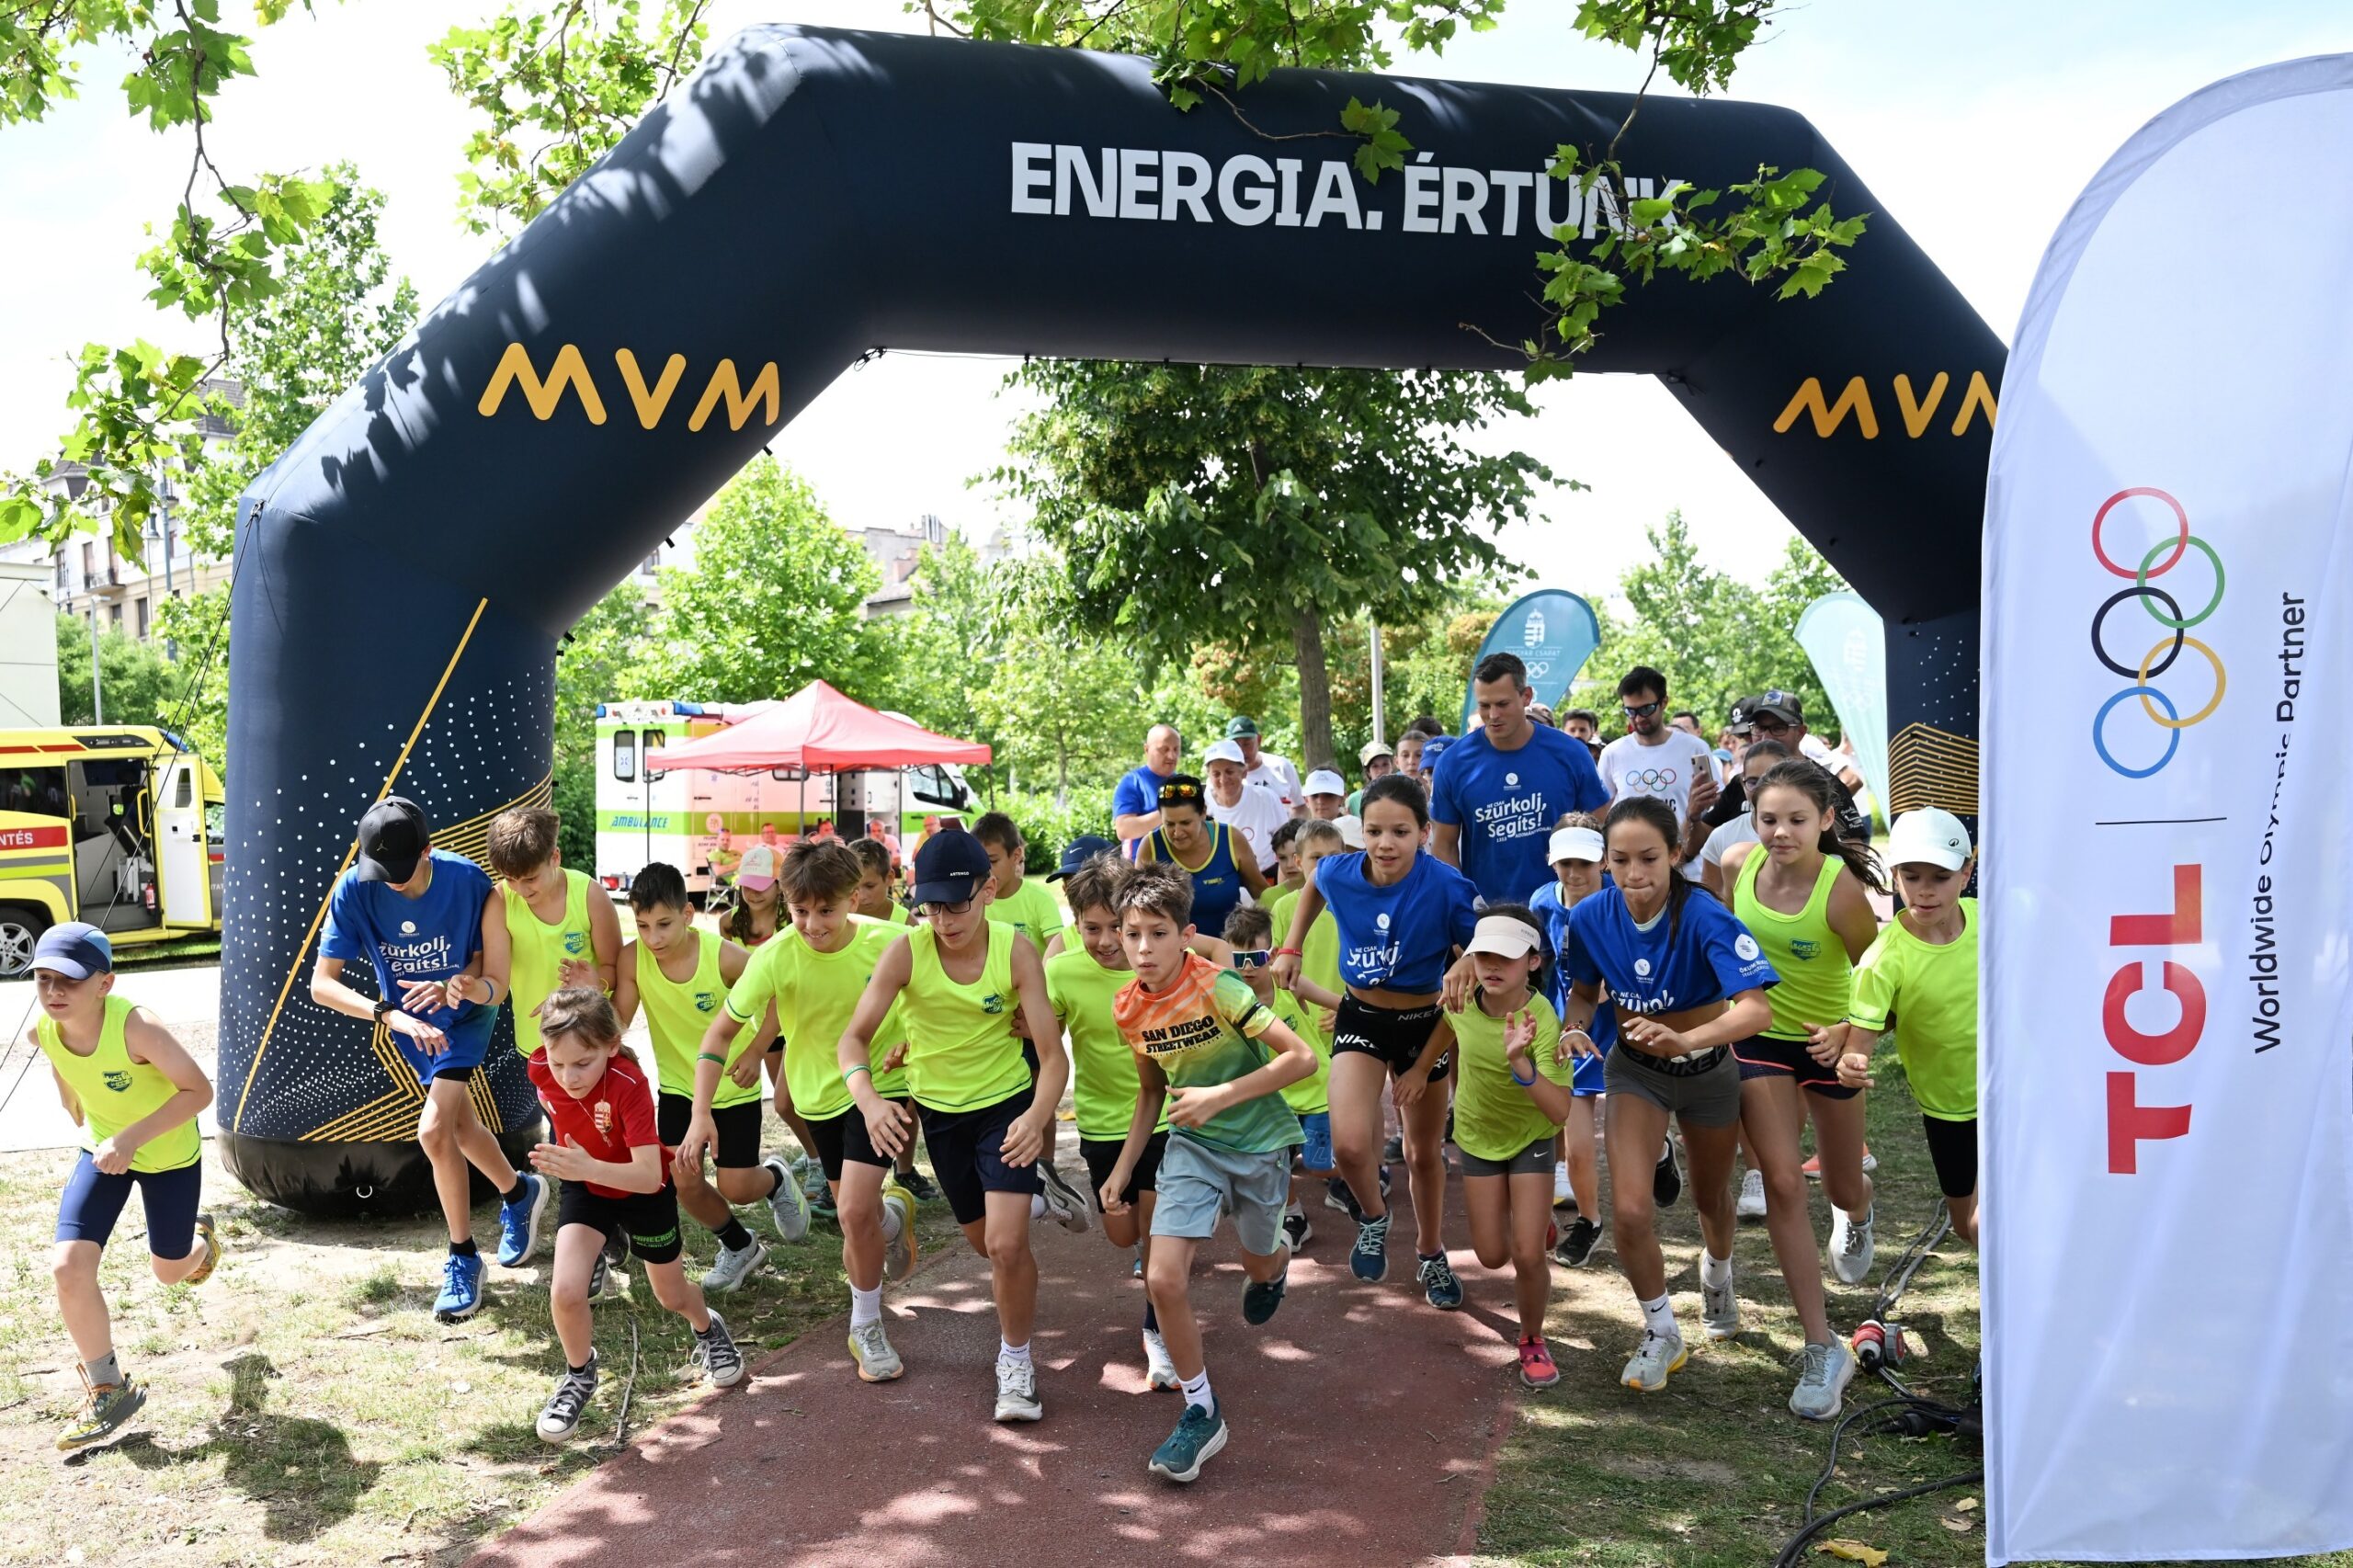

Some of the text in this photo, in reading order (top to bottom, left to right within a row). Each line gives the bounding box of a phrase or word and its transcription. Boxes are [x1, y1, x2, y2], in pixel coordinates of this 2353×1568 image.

[1011, 141, 1382, 231] ENERGIA.
[477, 342, 780, 433] MVM
[1474, 792, 1547, 823] Szurkolj,
[1487, 812, 1542, 838] Segíts!
[2248, 874, 2281, 1054] Worldwide
[2276, 591, 2305, 722] Partner
[379, 936, 451, 958] zurkolj,
[386, 950, 449, 973] egíts!
[1142, 1015, 1215, 1042] SAN DIEGO
[1397, 1010, 1434, 1021] NIKE
[2102, 863, 2207, 1175] TCL
[1145, 1026, 1222, 1054] STREETWEAR
